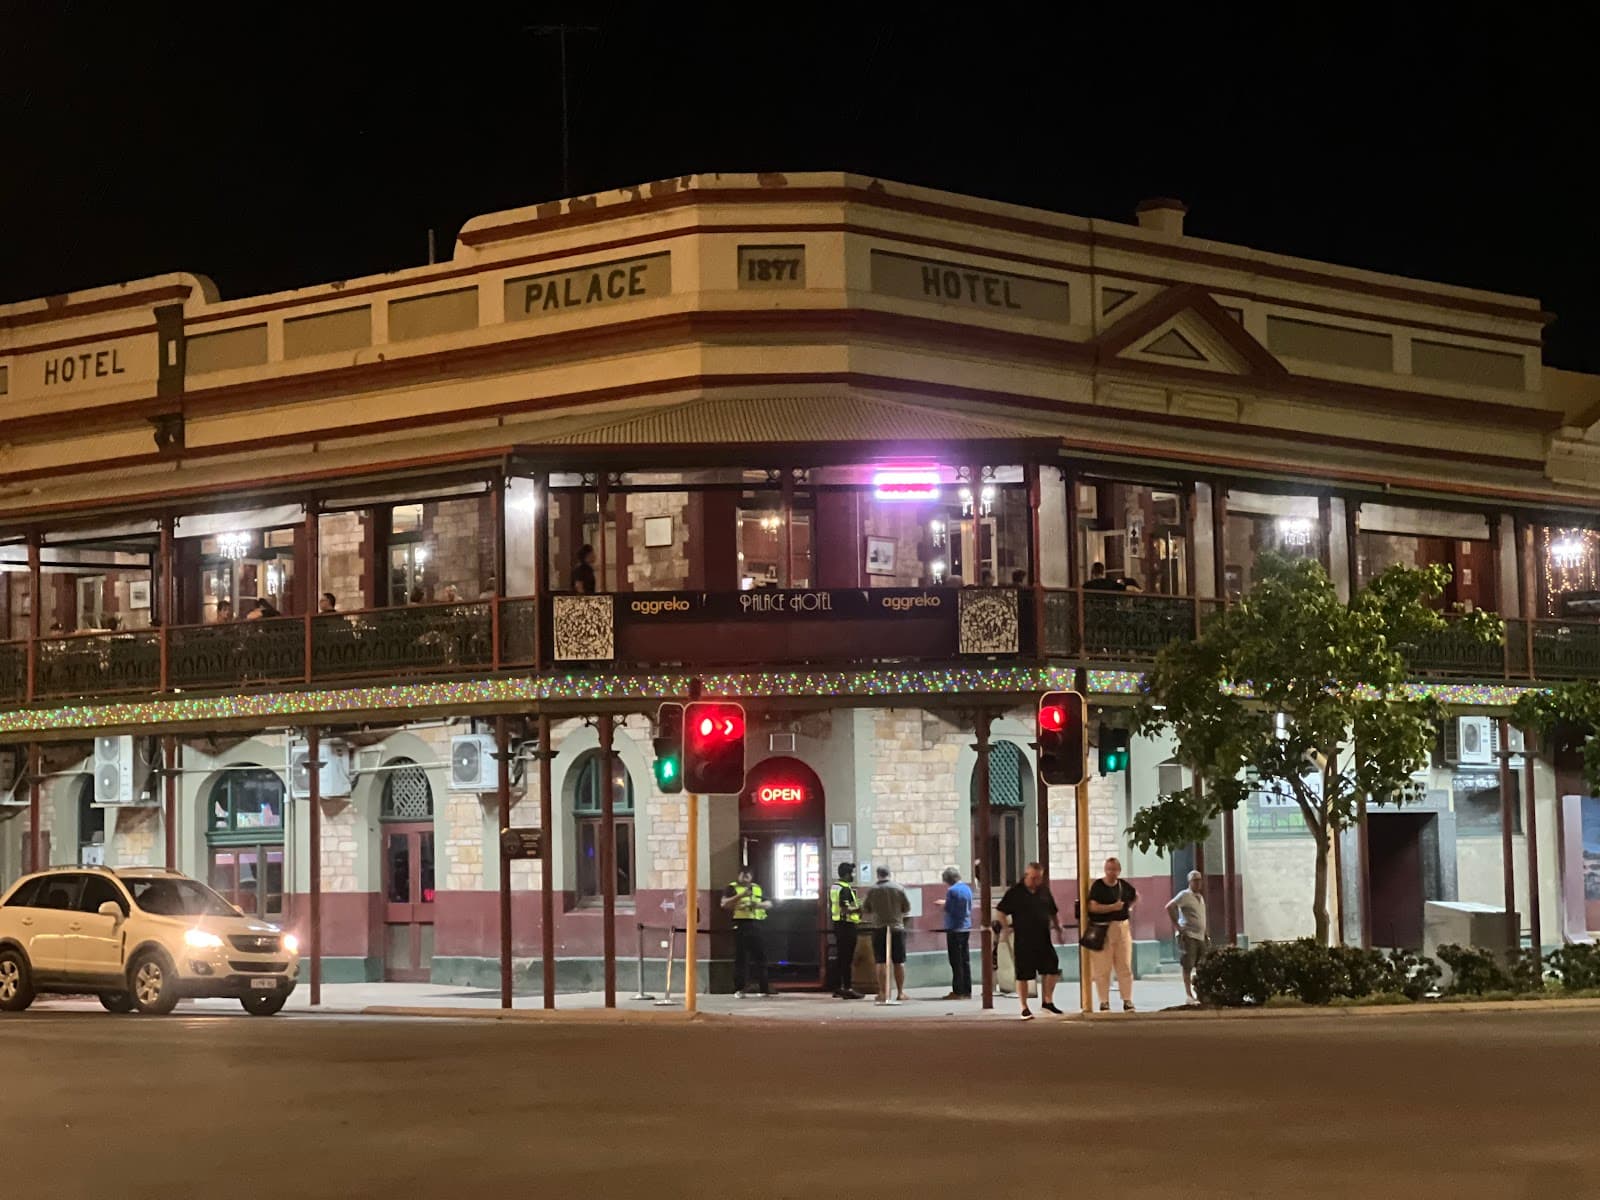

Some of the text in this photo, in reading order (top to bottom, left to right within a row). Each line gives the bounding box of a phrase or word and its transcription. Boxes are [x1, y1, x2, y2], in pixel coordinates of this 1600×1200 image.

[748, 259, 801, 281] 1897
[525, 265, 648, 313] PALACE
[922, 266, 1021, 309] HOTEL
[44, 349, 125, 385] HOTEL
[631, 595, 690, 615] aggreko
[740, 592, 833, 613] PALACE HOTEL
[882, 591, 941, 611] aggreko
[761, 788, 801, 802] OPEN
